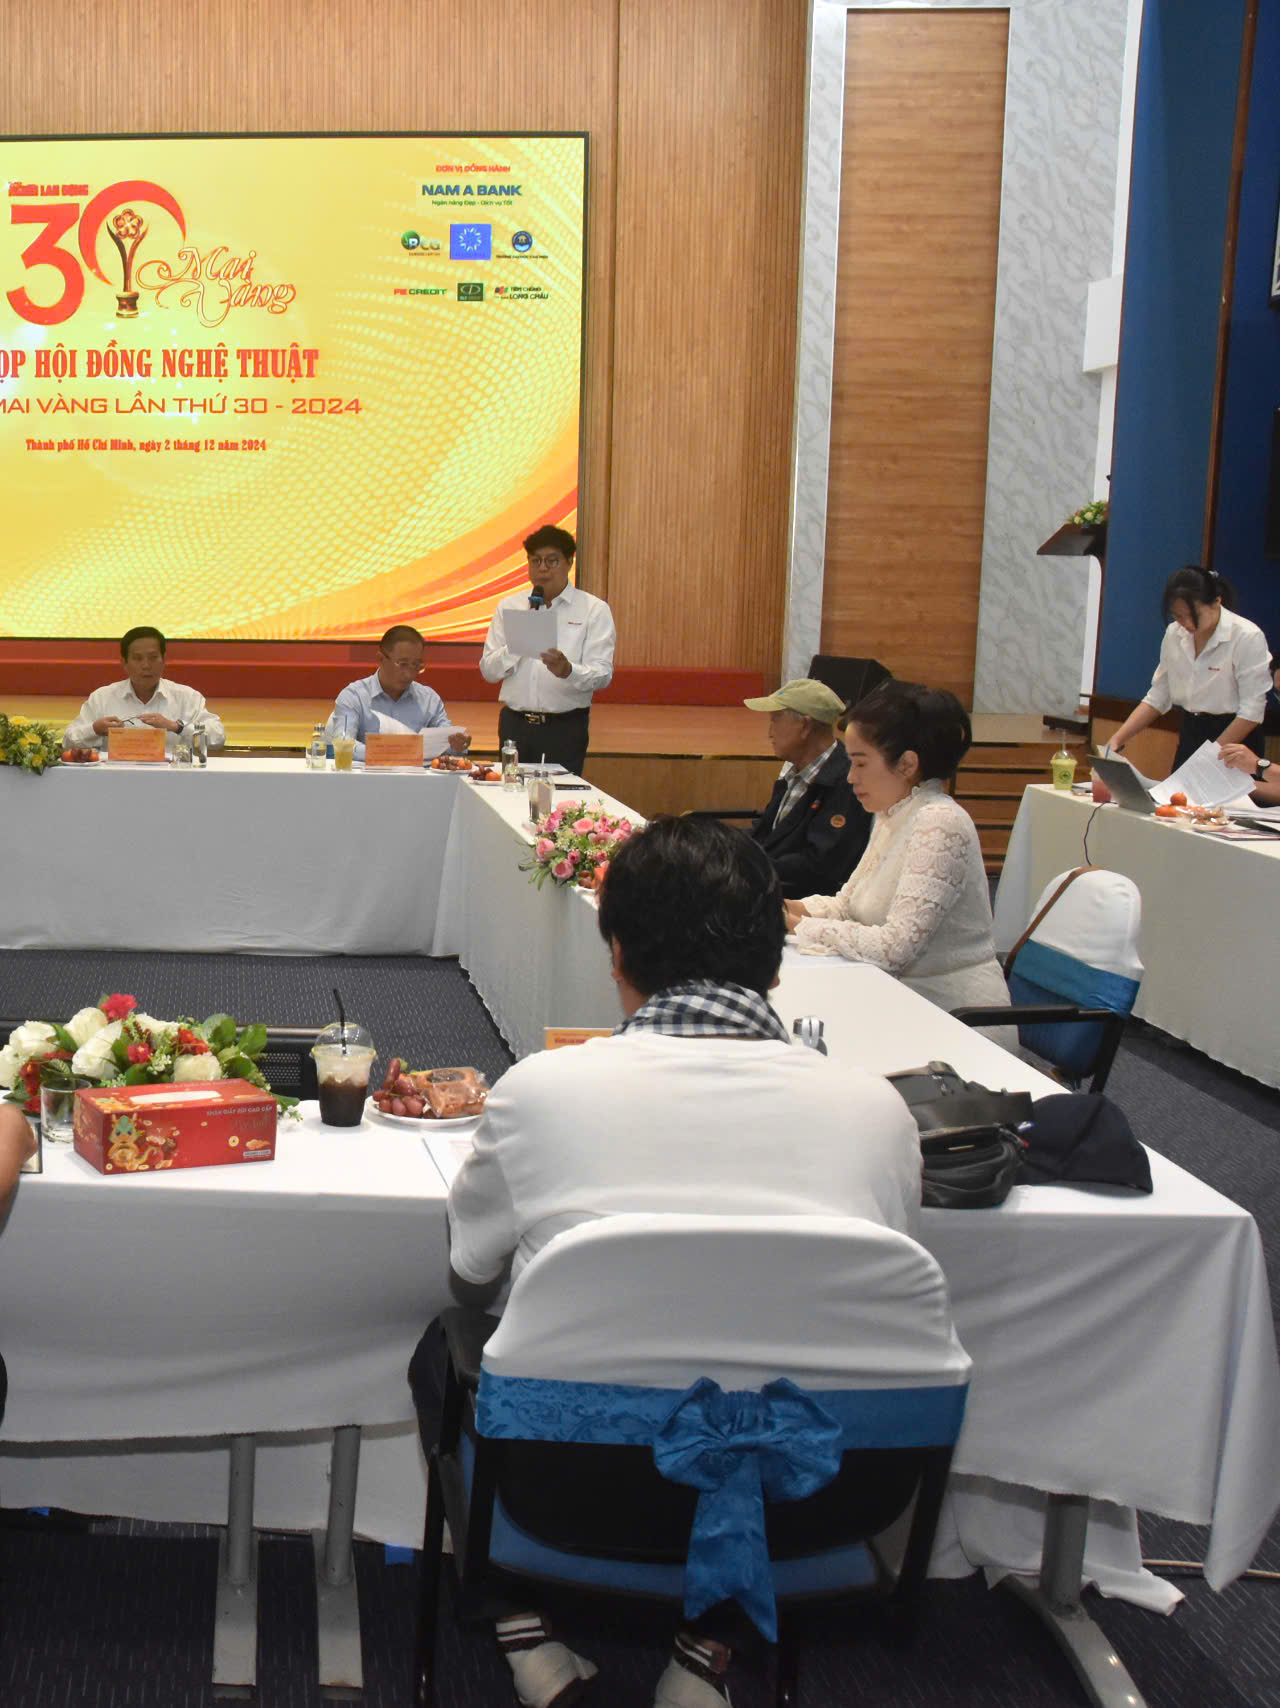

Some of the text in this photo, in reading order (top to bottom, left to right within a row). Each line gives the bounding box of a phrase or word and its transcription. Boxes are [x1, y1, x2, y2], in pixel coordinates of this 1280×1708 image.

[422, 184, 522, 196] NAM A BANK
[34, 343, 78, 384] HỘI
[86, 339, 152, 379] ĐỒNG
[161, 342, 229, 384] NGHỆ
[236, 342, 320, 384] THUẬT
[36, 392, 108, 415] VÀNG
[115, 390, 166, 415] LẦN
[173, 393, 228, 415] THỨ
[234, 398, 267, 415] 30
[292, 398, 363, 415] 2024
[26, 437, 266, 454] Thành phố Hồ Chí Minh, ngày 2 tháng 12 năm 2024
